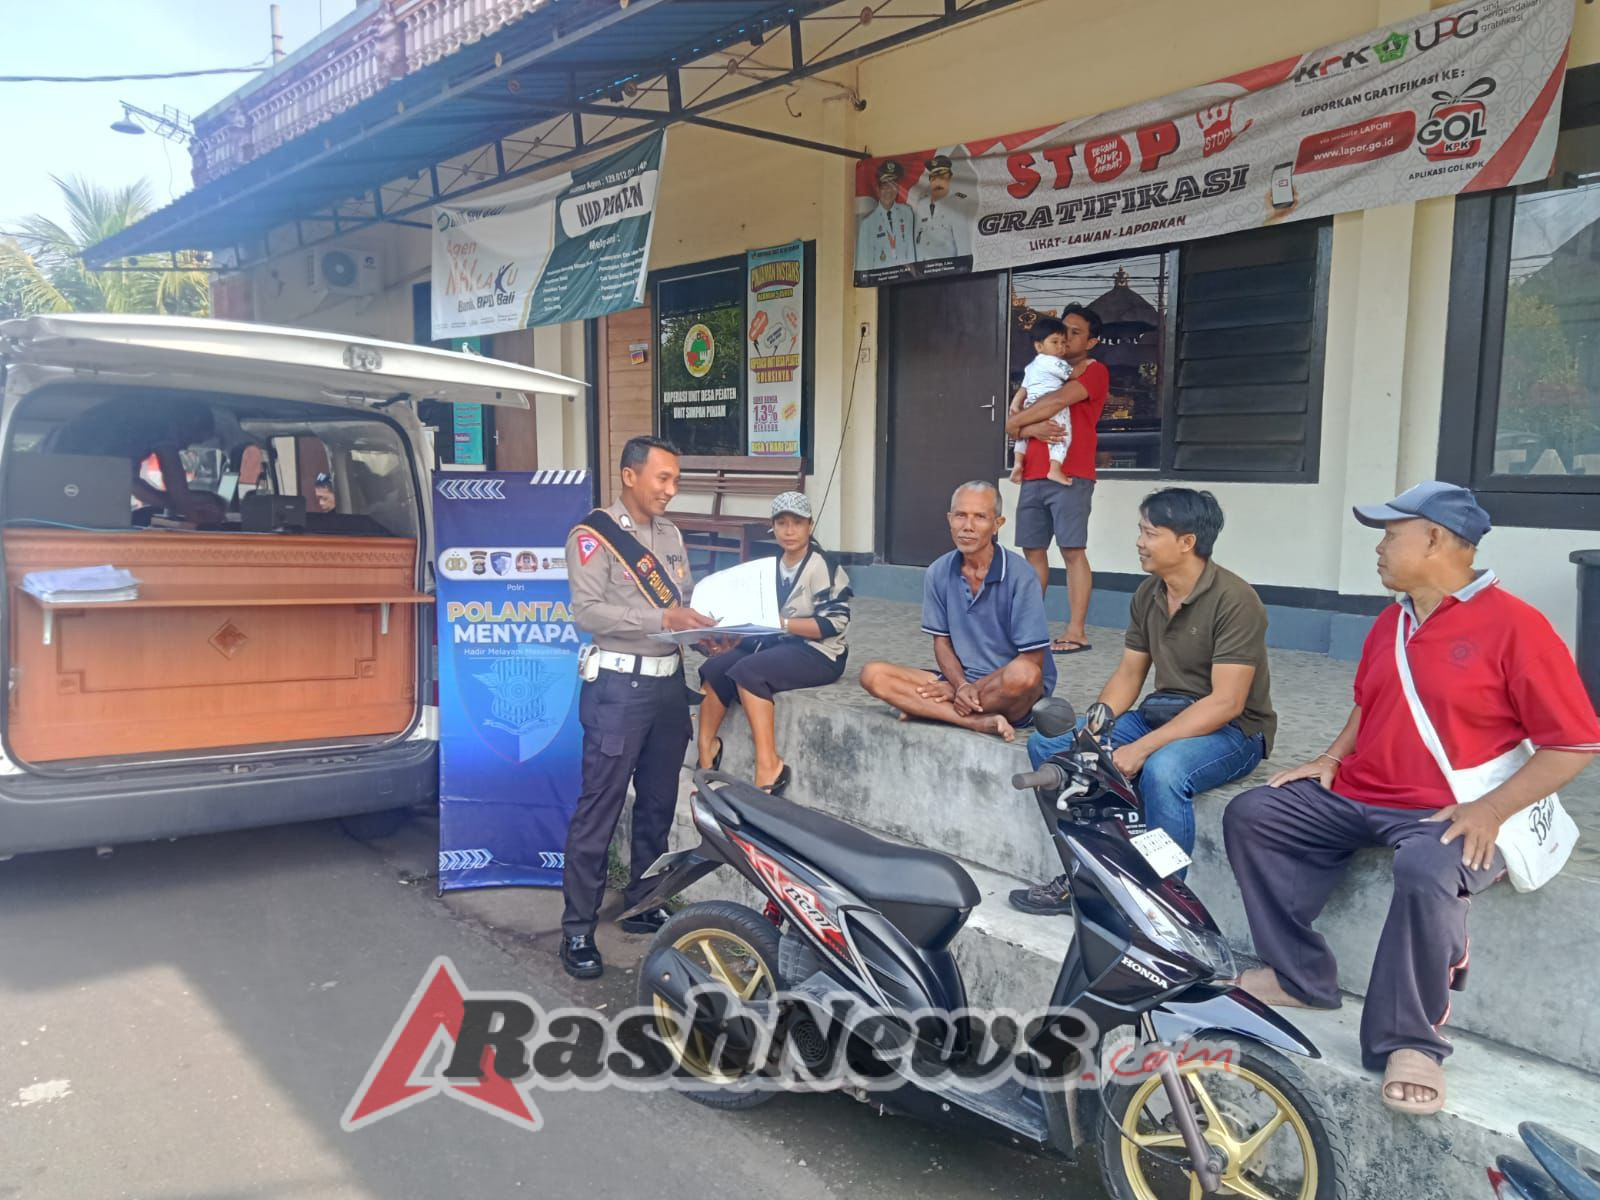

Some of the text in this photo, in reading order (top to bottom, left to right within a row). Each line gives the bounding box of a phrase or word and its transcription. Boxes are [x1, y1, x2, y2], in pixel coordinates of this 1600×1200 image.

[1294, 45, 1370, 82] KPK
[1301, 93, 1362, 117] LAPORKAN
[1364, 73, 1439, 102] GRATIFIKASI
[1205, 128, 1231, 151] STOP
[1417, 112, 1487, 146] GOL
[1314, 136, 1394, 160] www.lapor.go.id
[1445, 141, 1468, 152] KPK
[1006, 120, 1182, 199] STOP
[1408, 160, 1485, 180] APLIKASI GOL KPK
[978, 164, 1250, 236] GRATIFIKASI
[576, 199, 602, 228] KUD
[476, 294, 495, 310] BPD
[497, 290, 516, 306] Bali
[700, 389, 715, 402] DESA
[507, 583, 525, 592] Polri
[454, 623, 579, 644] MENYAPA
[464, 648, 486, 656] Hadir
[1121, 956, 1168, 989] HONDA
